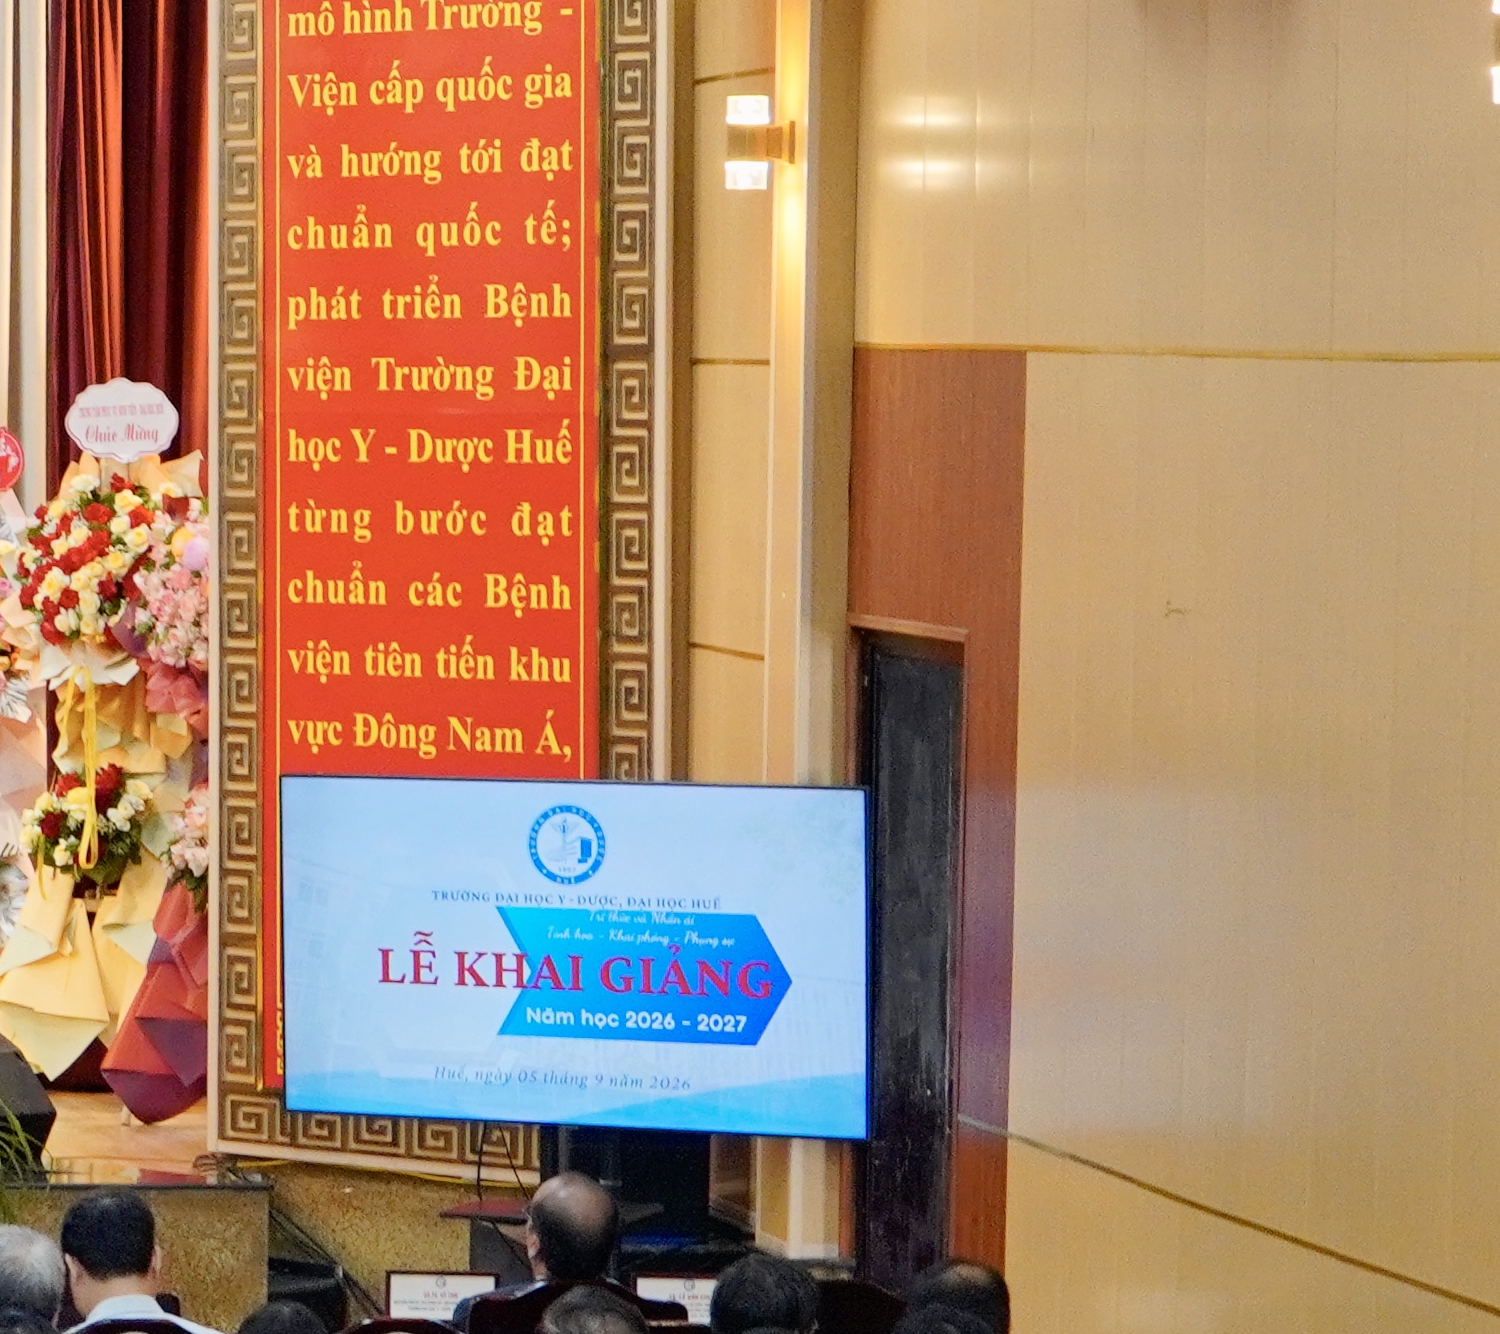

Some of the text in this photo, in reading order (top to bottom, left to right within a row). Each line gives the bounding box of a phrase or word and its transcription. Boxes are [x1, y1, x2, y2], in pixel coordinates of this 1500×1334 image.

[288, 1, 334, 37] mô
[343, 0, 413, 34] hình
[287, 56, 572, 116] Viện cấp quốc gia
[287, 138, 573, 184] và hướng tới đạt
[287, 200, 570, 256] chuẩn quốc tế;
[288, 275, 571, 330] phát triển Bệnh
[287, 356, 571, 400] viện Trường Đại
[289, 429, 340, 471] học
[351, 429, 375, 462] Y
[408, 429, 493, 472] Dược
[506, 419, 572, 463] Huế
[288, 499, 572, 545] từng bước đạt
[288, 561, 571, 617] chuẩn các Bệnh
[288, 635, 570, 682] viện tiên tiến khu
[288, 709, 571, 762] vực Đông Nam Á,
[378, 931, 773, 1000] LỄ KHAI GIẢNG
